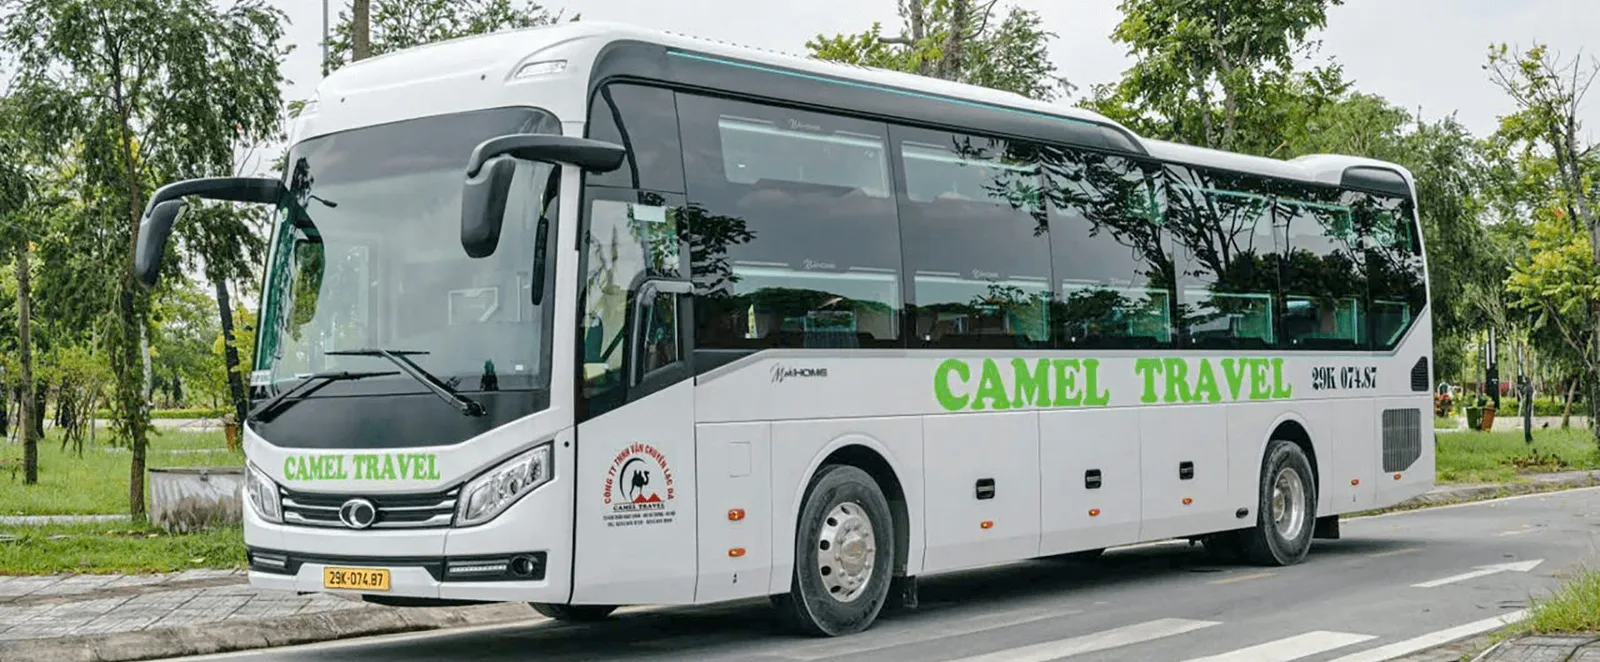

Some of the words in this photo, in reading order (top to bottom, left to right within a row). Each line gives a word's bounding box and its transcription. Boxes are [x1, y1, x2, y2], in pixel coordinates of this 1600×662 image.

[934, 357, 1110, 411] CAMEL
[1134, 357, 1292, 403] TRAVEL
[1312, 366, 1336, 390] 29K
[1340, 366, 1377, 389] 074.87
[284, 455, 348, 481] CAMEL
[353, 453, 440, 480] TRAVEL
[329, 571, 384, 586] 29K-074.87
